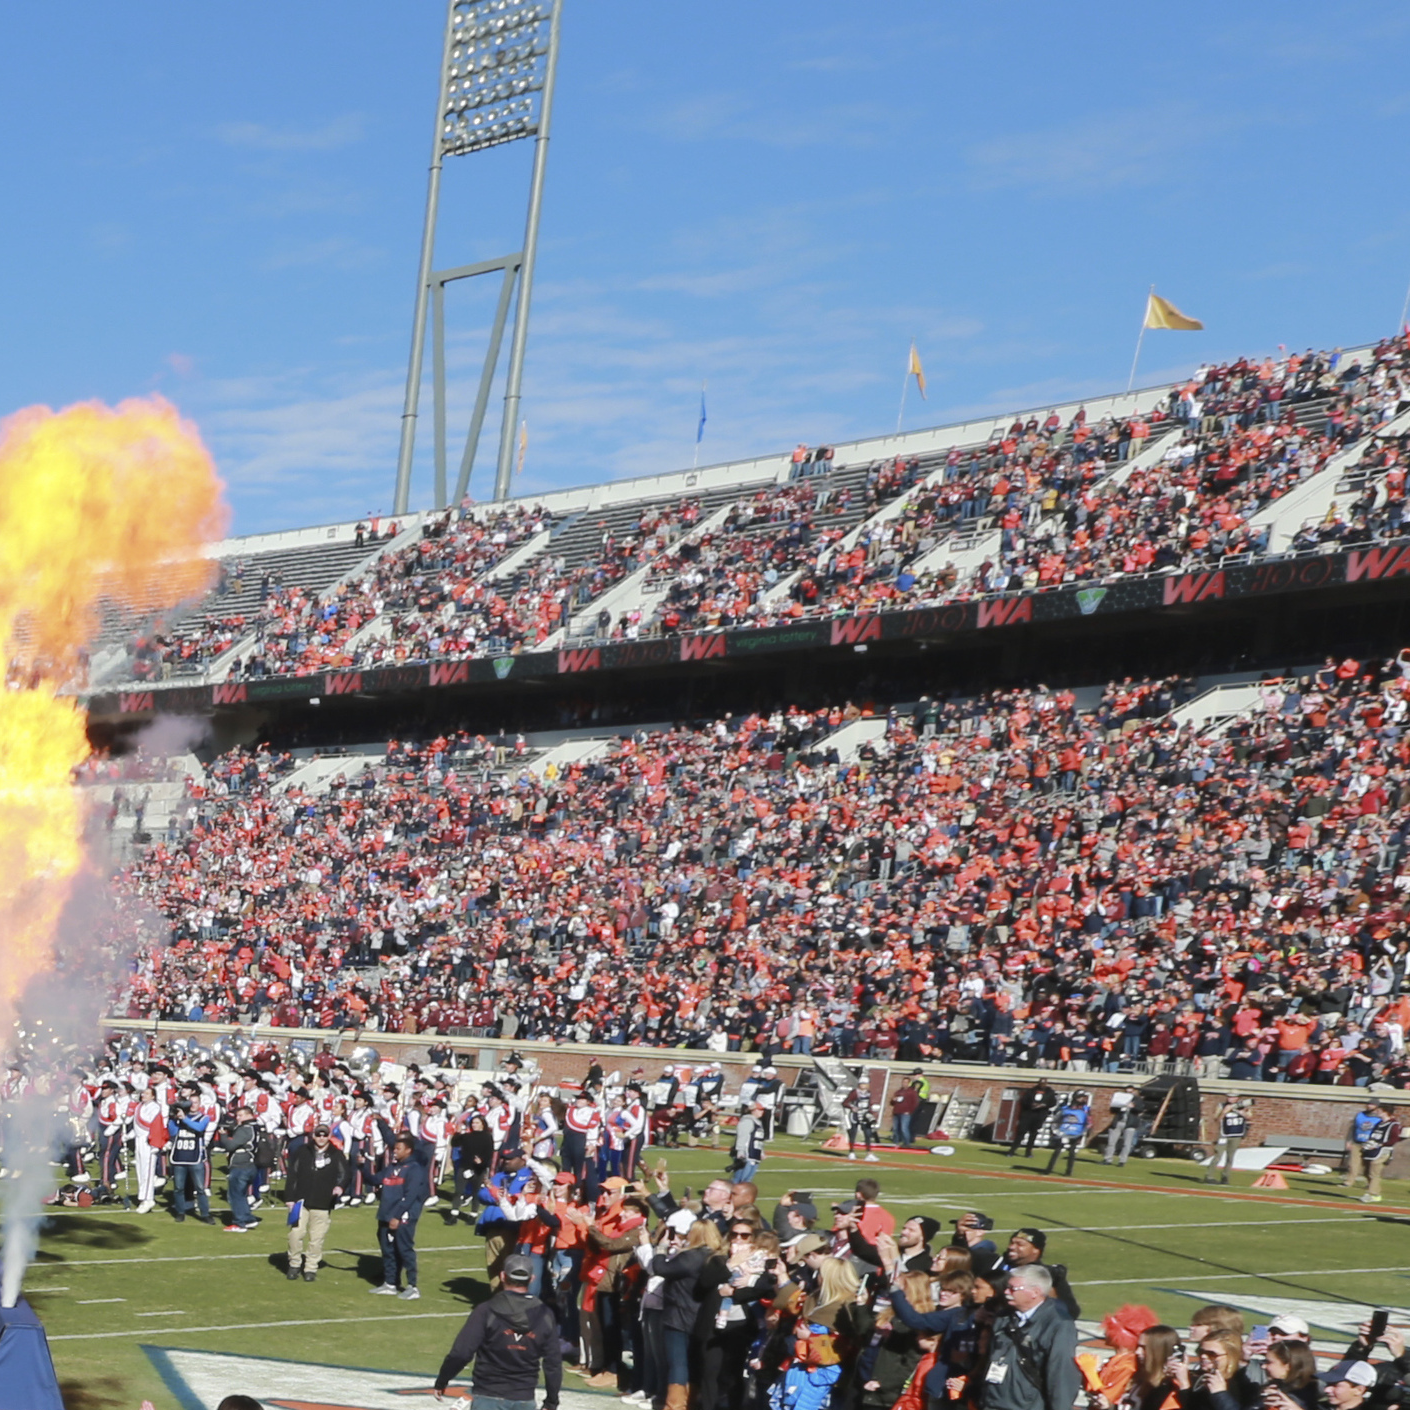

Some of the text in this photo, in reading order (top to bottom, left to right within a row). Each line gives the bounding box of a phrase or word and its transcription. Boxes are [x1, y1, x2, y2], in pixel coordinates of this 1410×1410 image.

[1164, 571, 1225, 605] WA
[977, 597, 1032, 628] WA
[736, 629, 817, 649] virginia lottery
[830, 617, 881, 645] WA
[680, 634, 727, 661] WA
[558, 648, 600, 673] WA
[325, 673, 362, 695] WA
[429, 662, 469, 686] WA
[120, 693, 154, 712] WA
[213, 684, 247, 705] WA
[177, 1140, 195, 1150] 083
